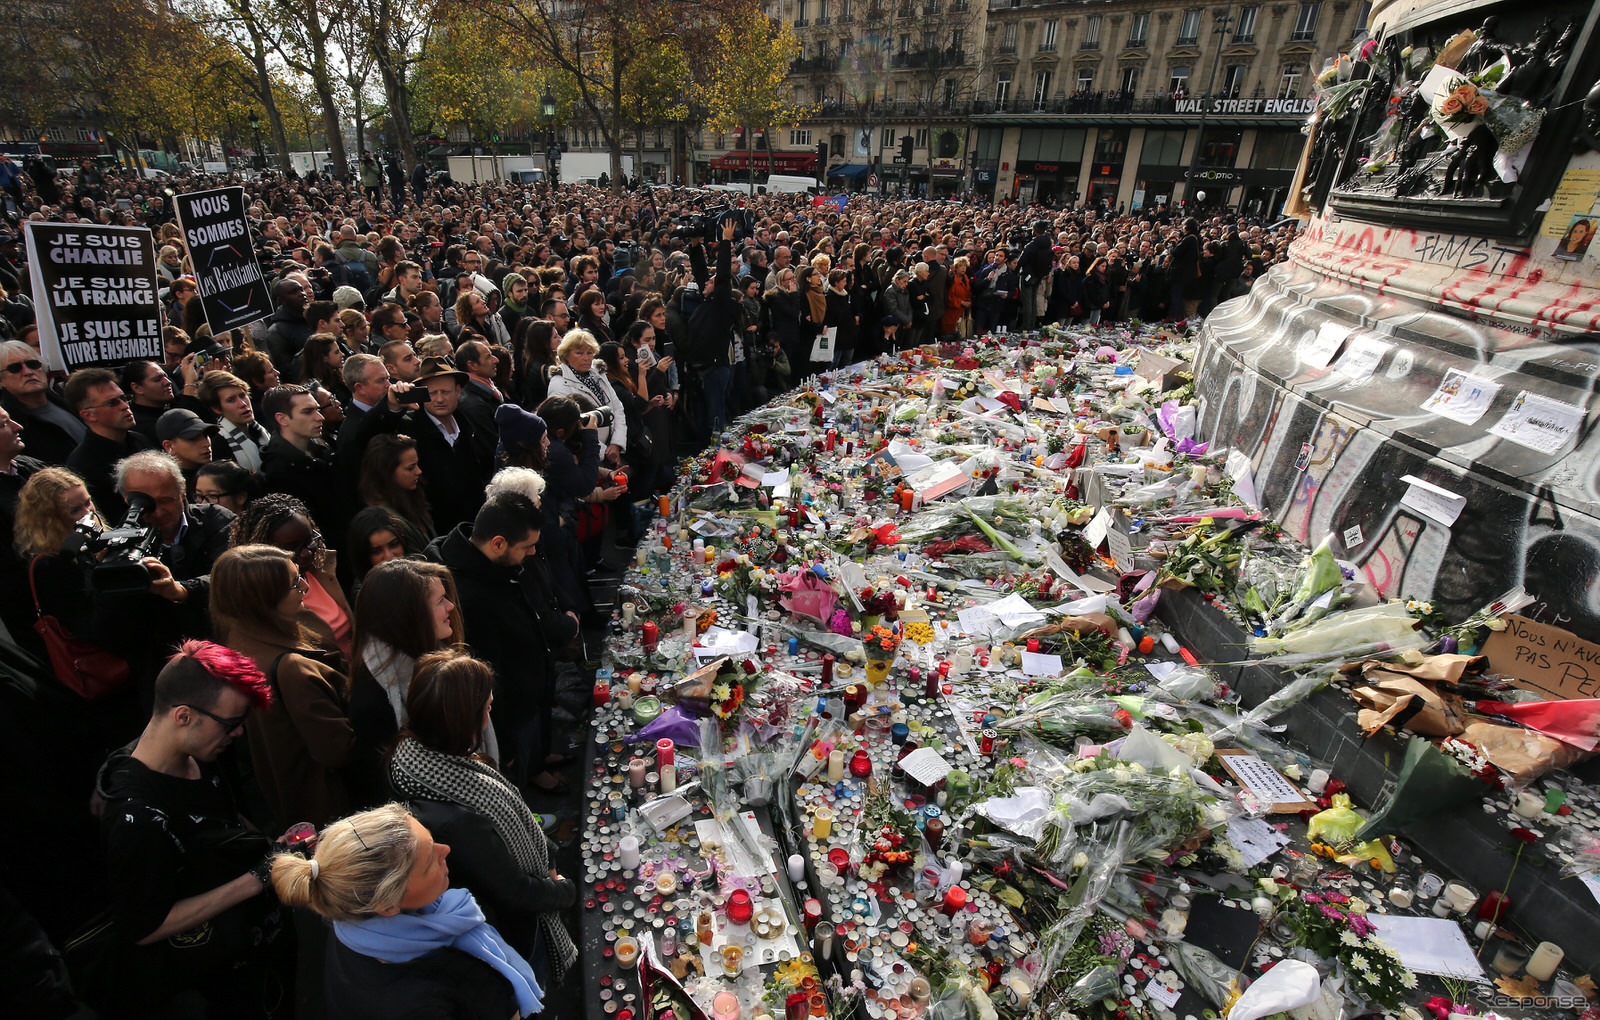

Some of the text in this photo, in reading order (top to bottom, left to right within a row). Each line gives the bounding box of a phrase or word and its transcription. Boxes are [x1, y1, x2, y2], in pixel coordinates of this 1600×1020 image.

[1175, 99, 1209, 112] WAL
[1213, 99, 1262, 113] STREET
[1034, 163, 1059, 172] Orange
[190, 195, 230, 218] NOUS
[49, 234, 142, 248] JE SUIS
[187, 218, 245, 247] SOMMES
[50, 247, 144, 265] CHARLIE
[53, 277, 151, 289] JE SUIS
[196, 257, 261, 298] Les Résistants
[53, 289, 155, 307] LA FRANCE
[60, 319, 158, 342] JE SUIS LE
[63, 337, 161, 365] VIVRE ENSEMBLE
[1515, 645, 1551, 669] PAS
[1265, 775, 1288, 797] DEVANT
